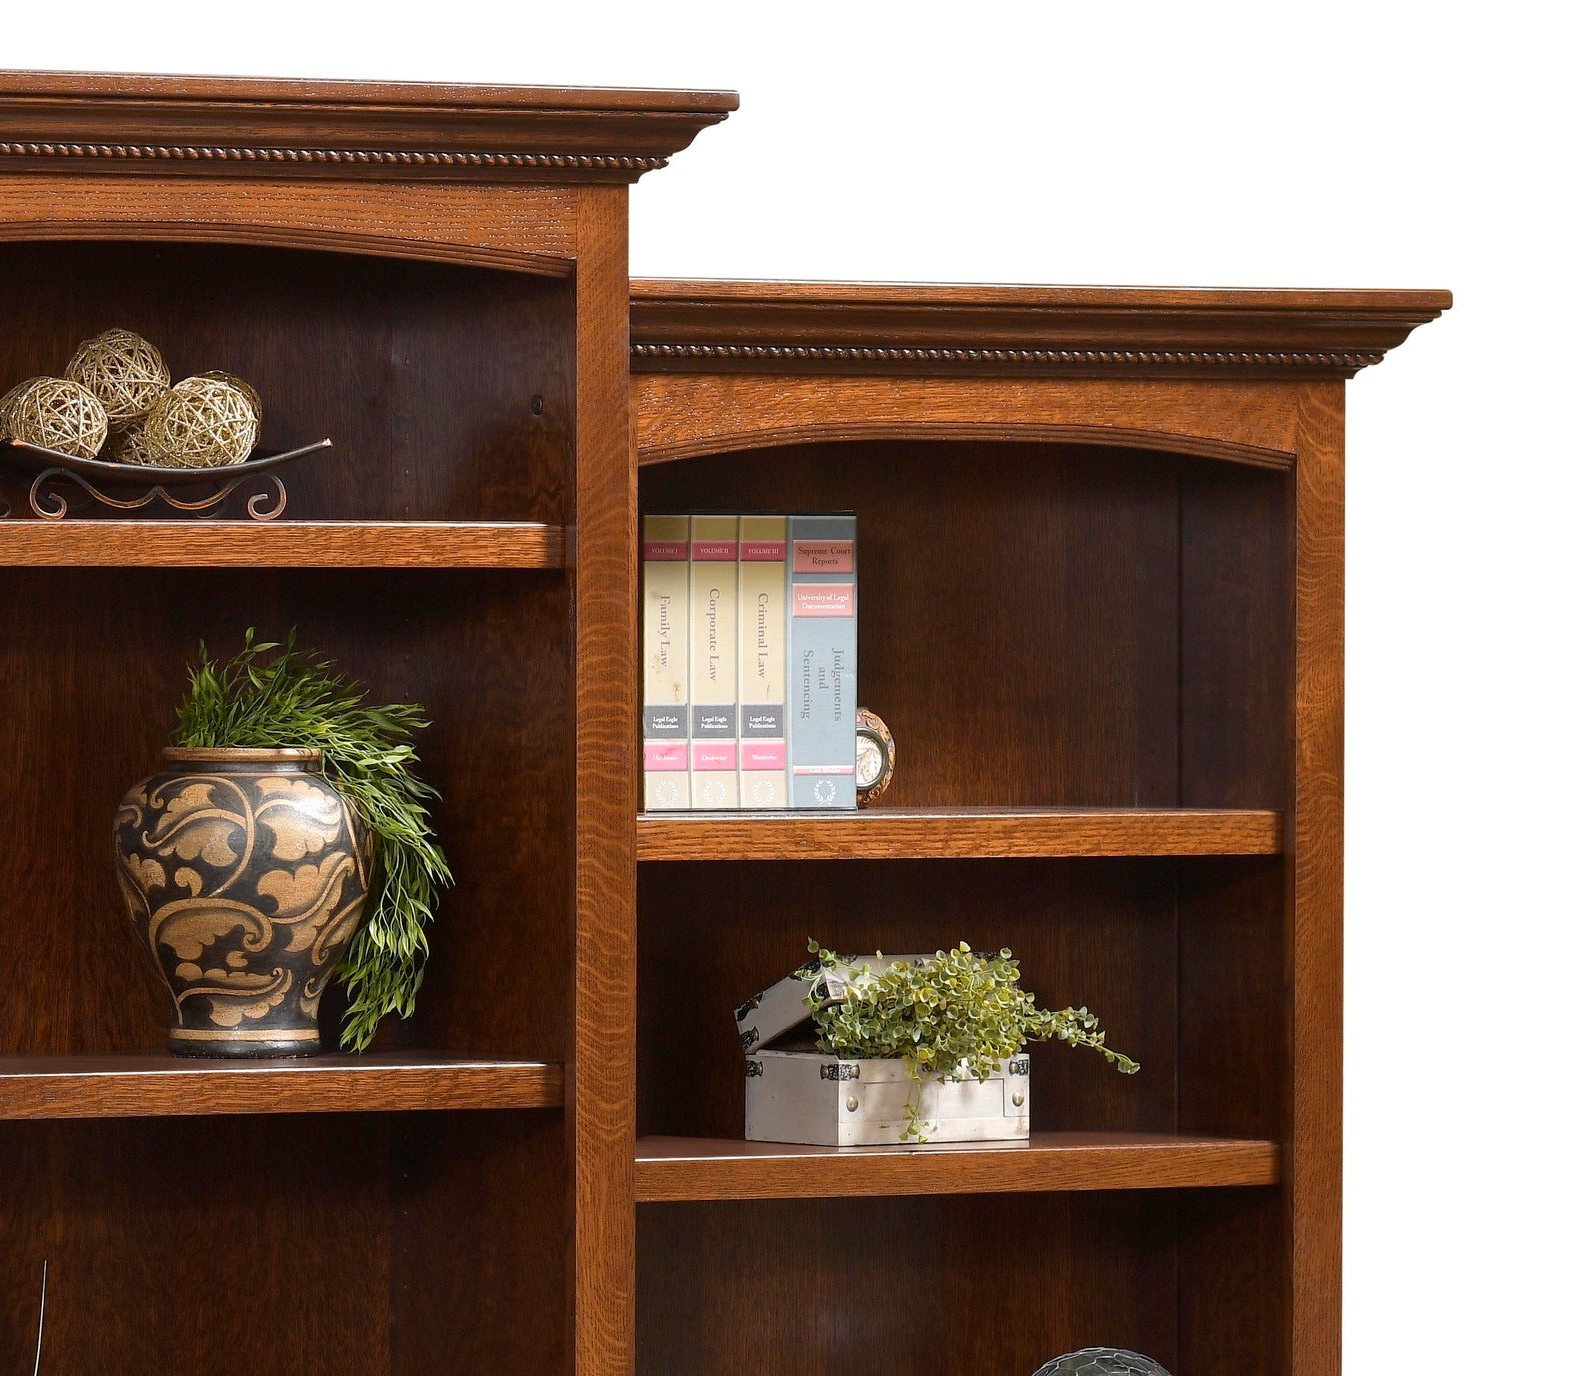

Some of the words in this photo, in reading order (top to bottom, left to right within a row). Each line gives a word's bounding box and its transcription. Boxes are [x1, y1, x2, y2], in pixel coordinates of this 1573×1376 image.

[797, 546, 828, 556] Supreme
[830, 546, 851, 555] Court
[812, 557, 838, 566] Reports
[797, 593, 826, 602] University
[833, 593, 850, 602] Legal
[802, 602, 846, 610] Documentation
[658, 595, 671, 637] Family
[706, 588, 720, 652] Corporate
[758, 593, 769, 648] Criminal
[660, 641, 671, 667] Law
[758, 652, 768, 678] Law
[709, 655, 720, 681] Law
[818, 666, 829, 690] and
[800, 649, 814, 720] Sentencing
[831, 648, 845, 722] Judgements
